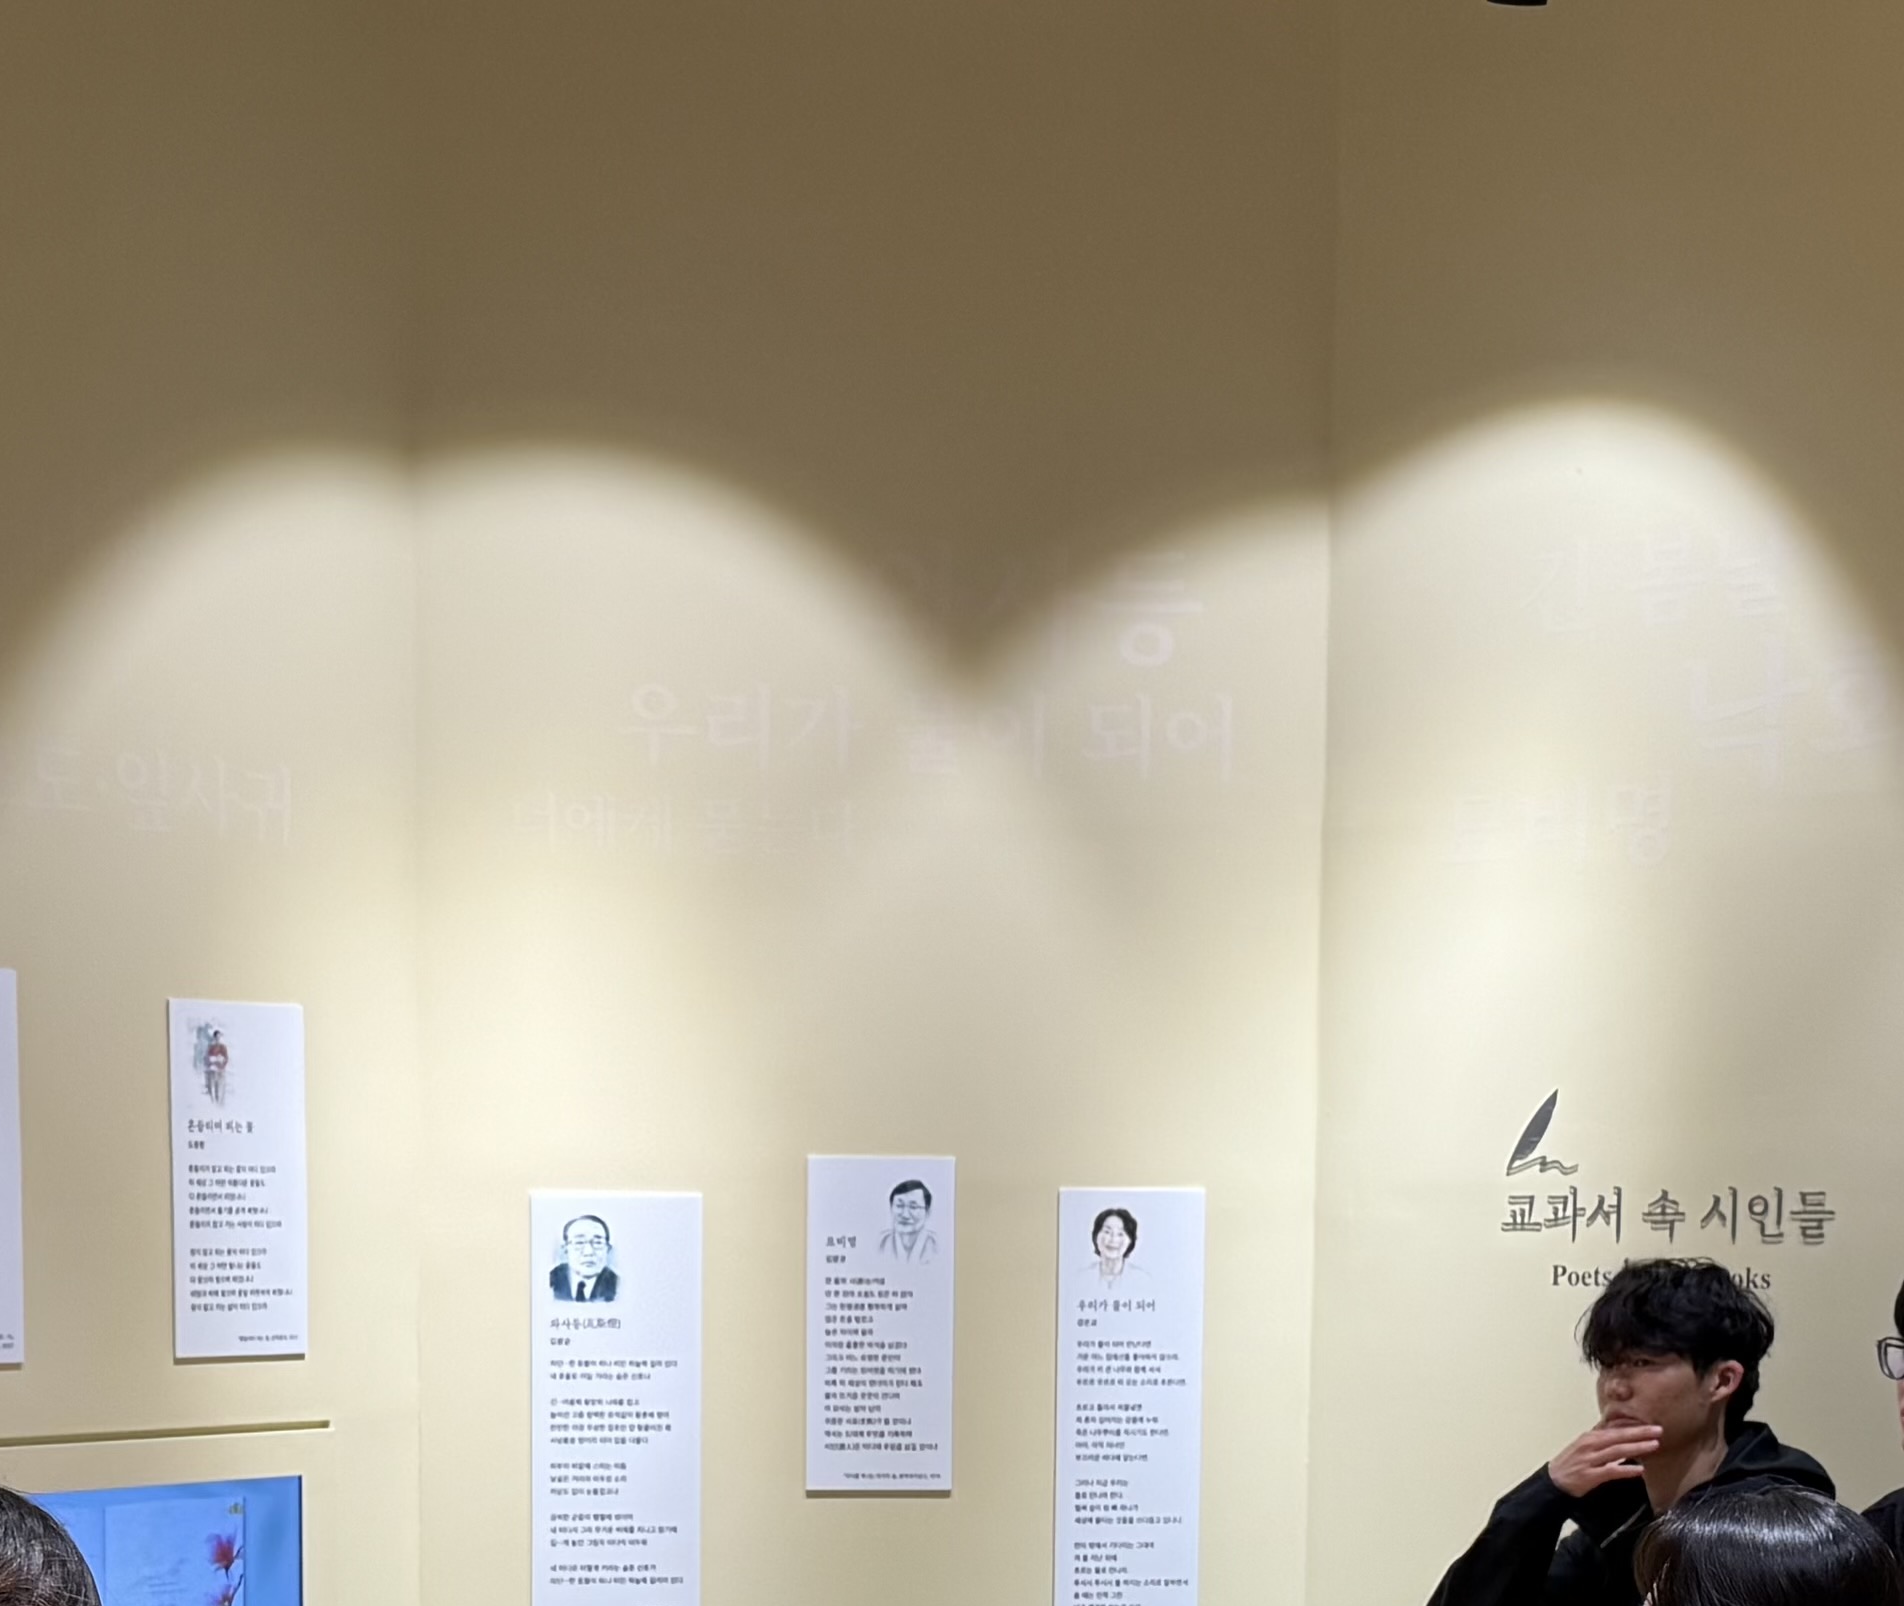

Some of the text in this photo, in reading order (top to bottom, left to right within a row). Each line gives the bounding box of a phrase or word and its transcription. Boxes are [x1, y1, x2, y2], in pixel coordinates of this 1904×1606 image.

[1500, 1185, 1836, 1246] 교과서 속 시인들
[1551, 1262, 1613, 1288] Poets
[1077, 1299, 1108, 1312] 우리가
